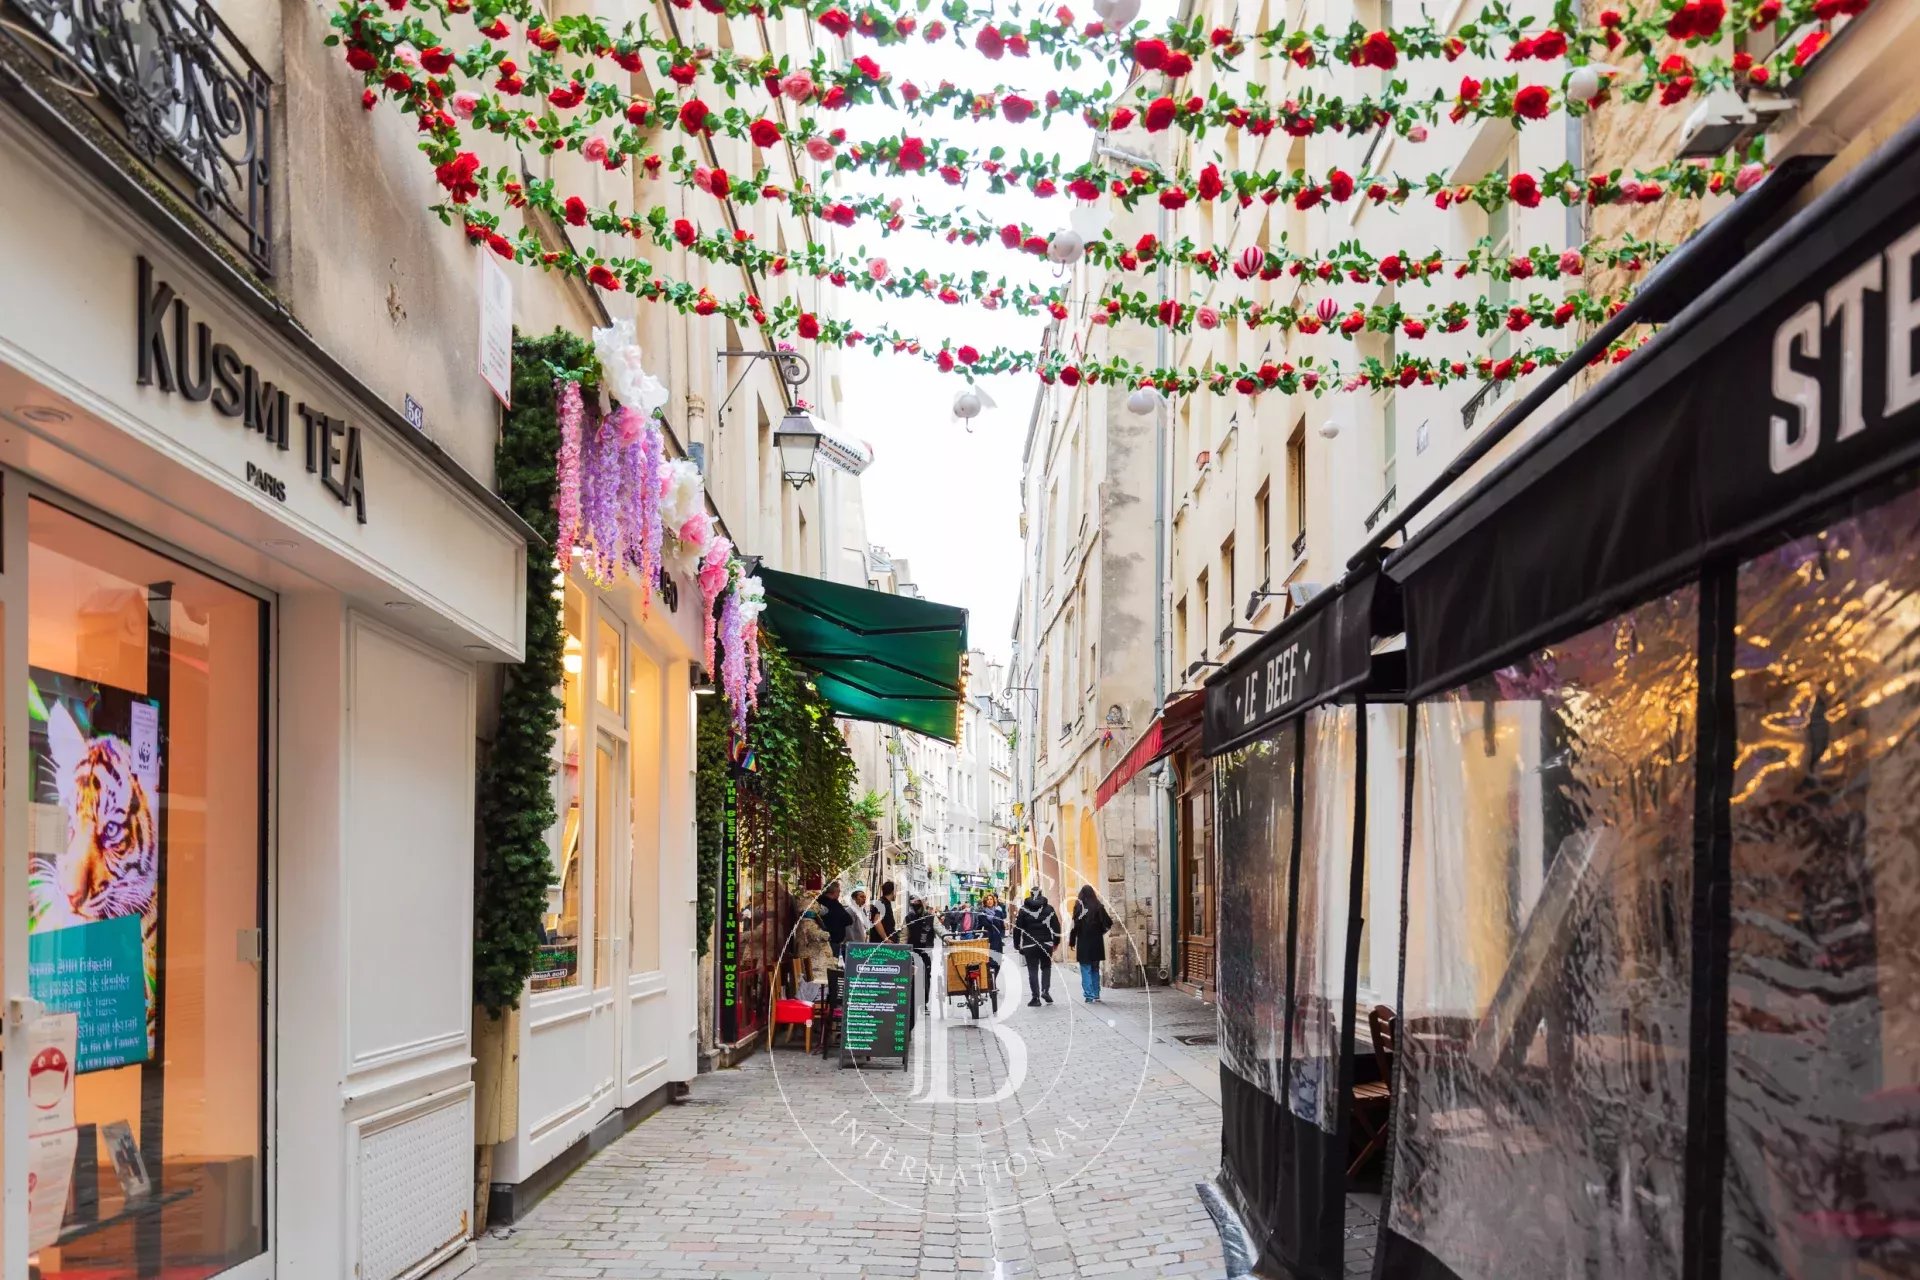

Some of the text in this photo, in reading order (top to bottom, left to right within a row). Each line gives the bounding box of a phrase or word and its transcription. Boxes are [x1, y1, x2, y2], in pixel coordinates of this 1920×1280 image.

[137, 255, 290, 451] KUSMI
[298, 402, 367, 524] TEA
[246, 461, 286, 502] PARIS
[1243, 642, 1299, 725] LE BEEF
[724, 780, 736, 1006] THE BEST FALLAFEL IN THE WORLD
